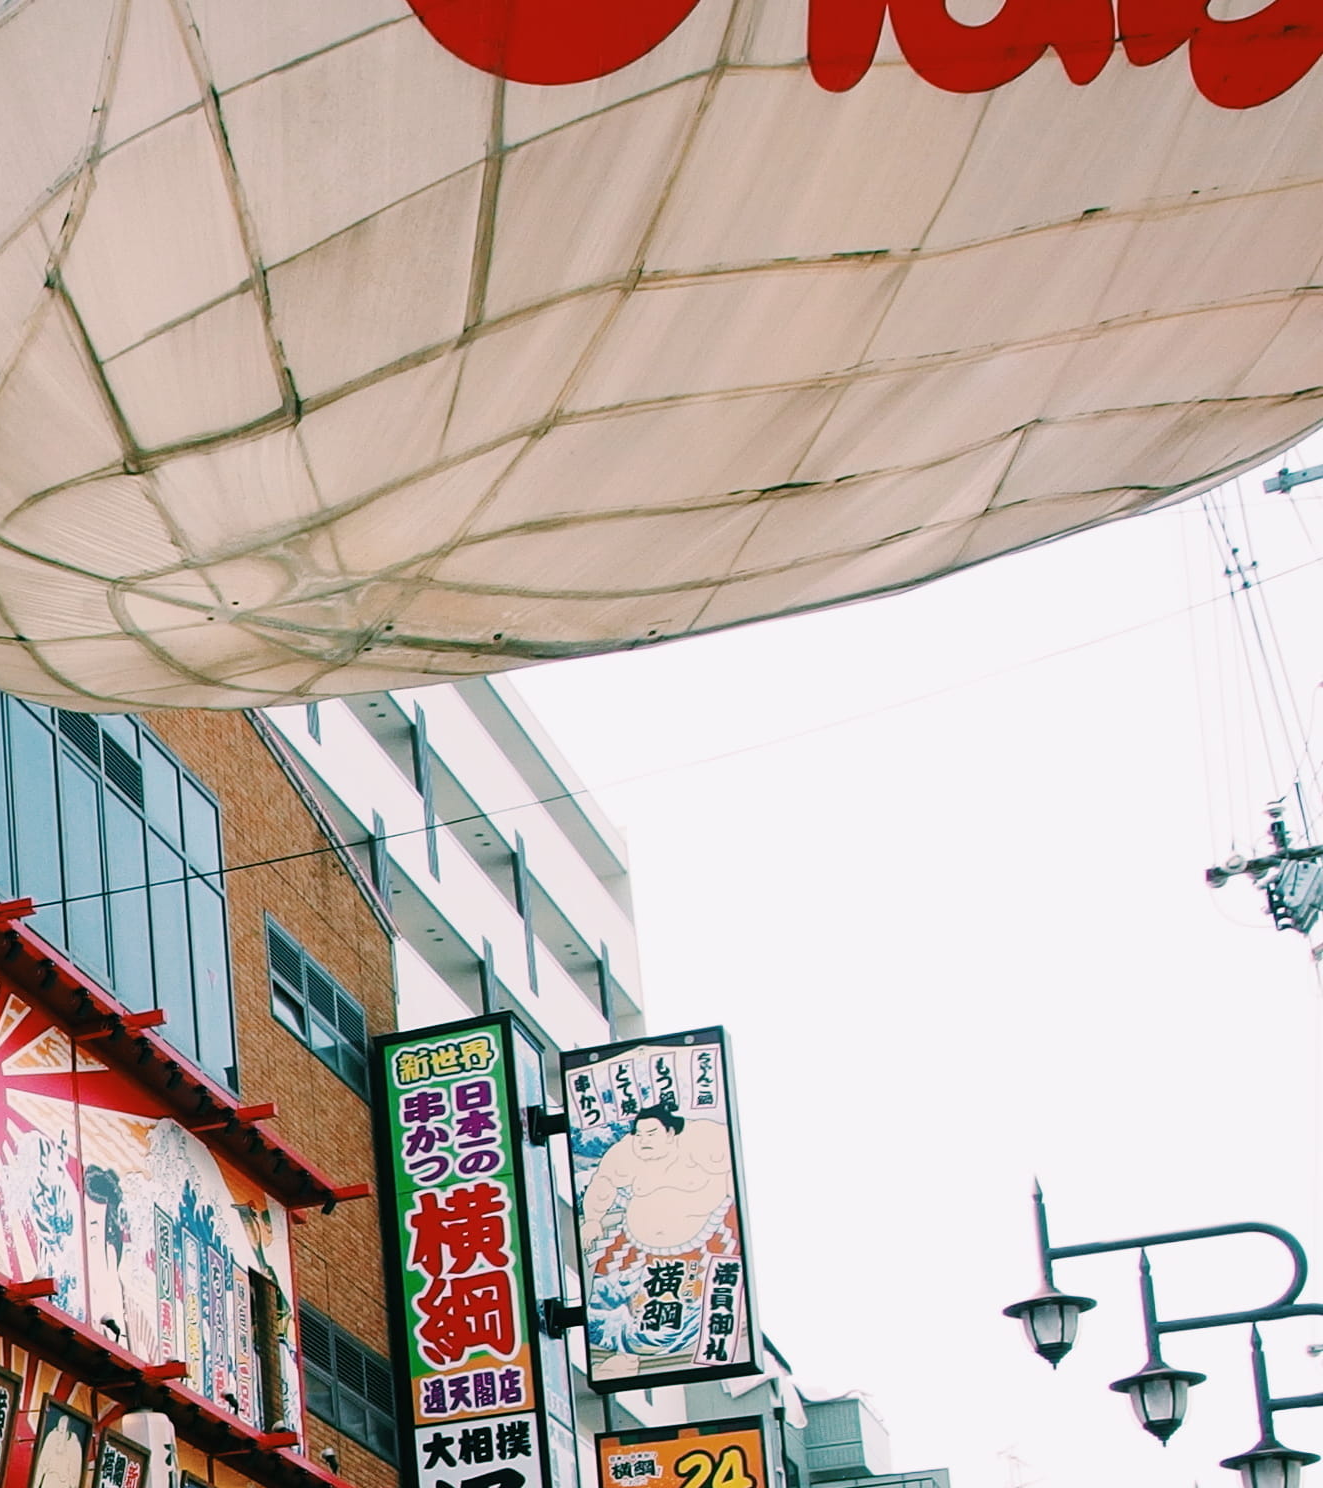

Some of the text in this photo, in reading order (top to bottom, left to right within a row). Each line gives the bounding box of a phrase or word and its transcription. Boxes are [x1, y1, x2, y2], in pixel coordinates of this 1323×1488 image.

[395, 1037, 495, 1083] 新世界
[453, 1079, 495, 1175] 日本一の
[572, 1073, 601, 1127] 串かつ
[402, 1091, 451, 1184] 串かつ
[408, 1184, 518, 1368] 横綱
[639, 1260, 686, 1333] 横綱
[421, 1368, 524, 1416] 通天閣店
[422, 1420, 533, 1471] 大相撲
